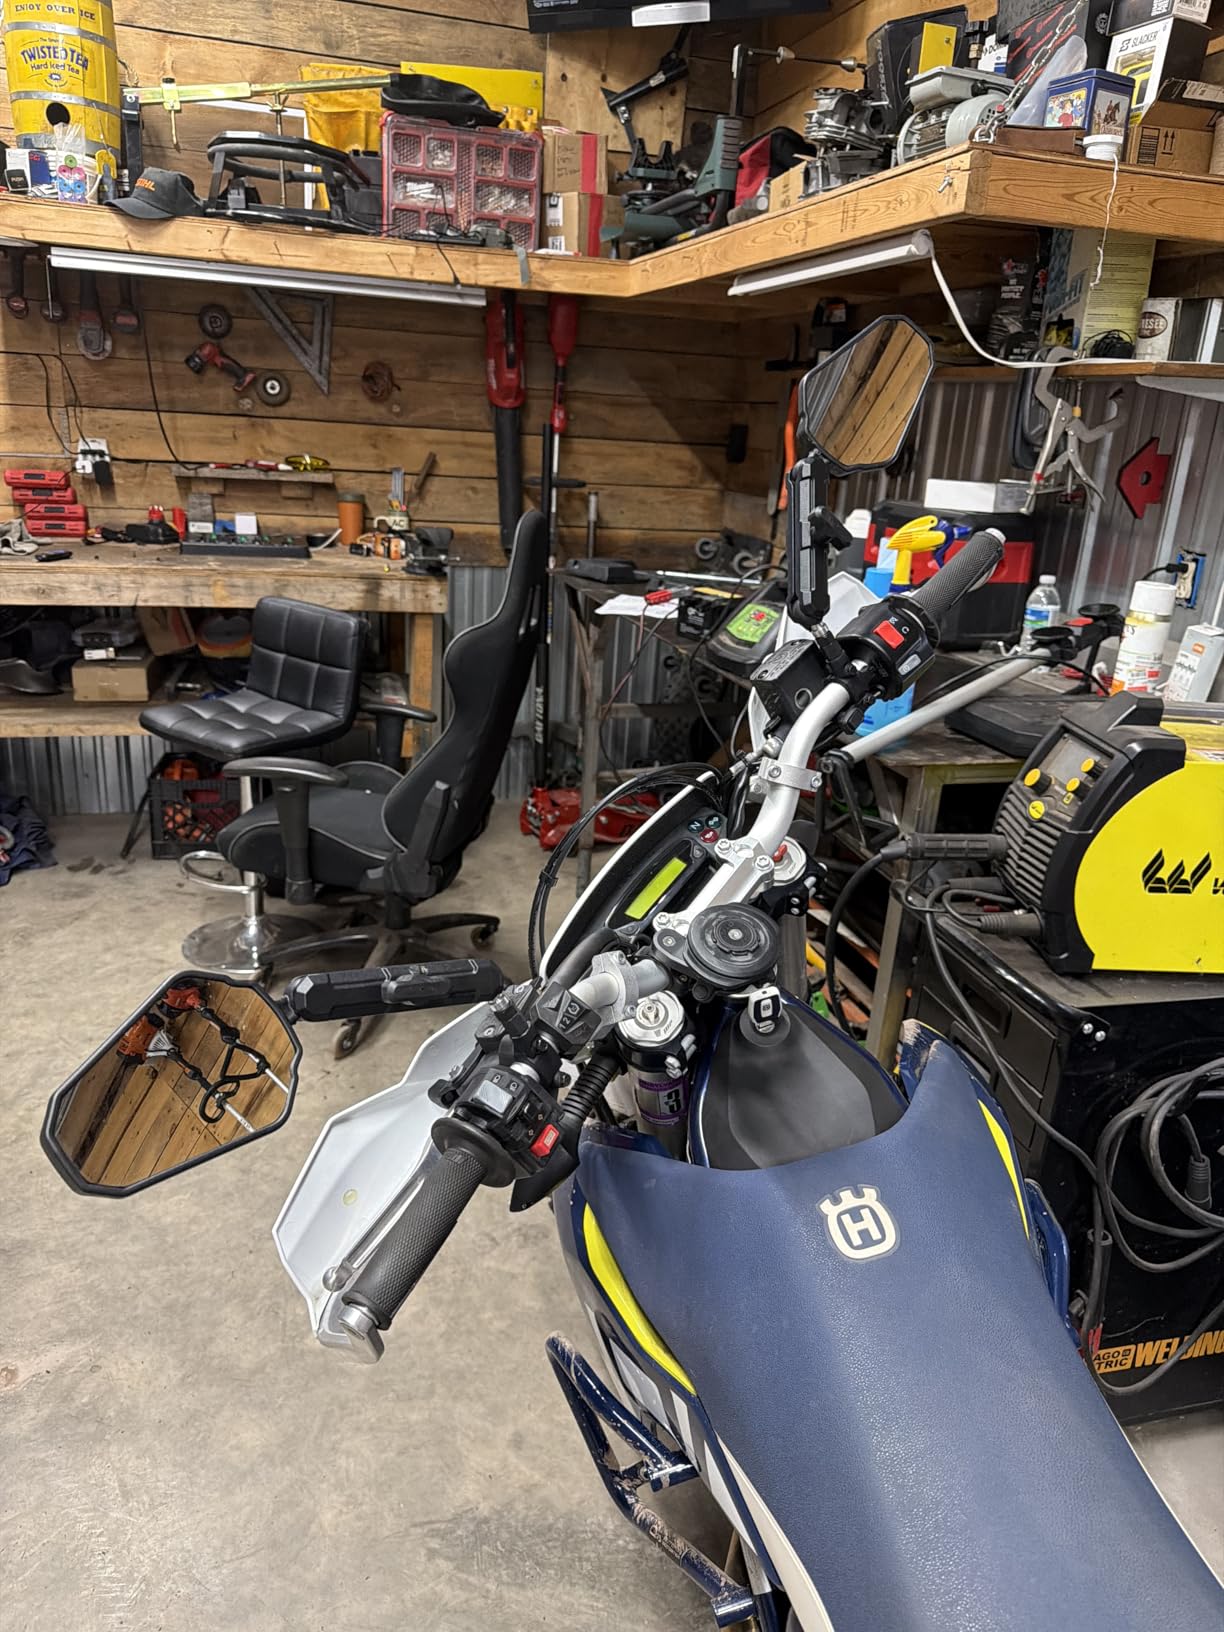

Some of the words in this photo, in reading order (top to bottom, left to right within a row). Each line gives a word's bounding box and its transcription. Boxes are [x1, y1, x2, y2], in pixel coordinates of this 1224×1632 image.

[15, 3, 42, 12] ENJOY
[46, 4, 76, 14] OVER
[80, 9, 96, 20] ICE
[1131, 30, 1159, 48] SLACKER
[20, 45, 68, 64] TWISTED
[69, 47, 89, 71] TEA
[31, 61, 48, 71] Hard
[67, 63, 80, 75] Tea
[840, 1207, 882, 1247] H
